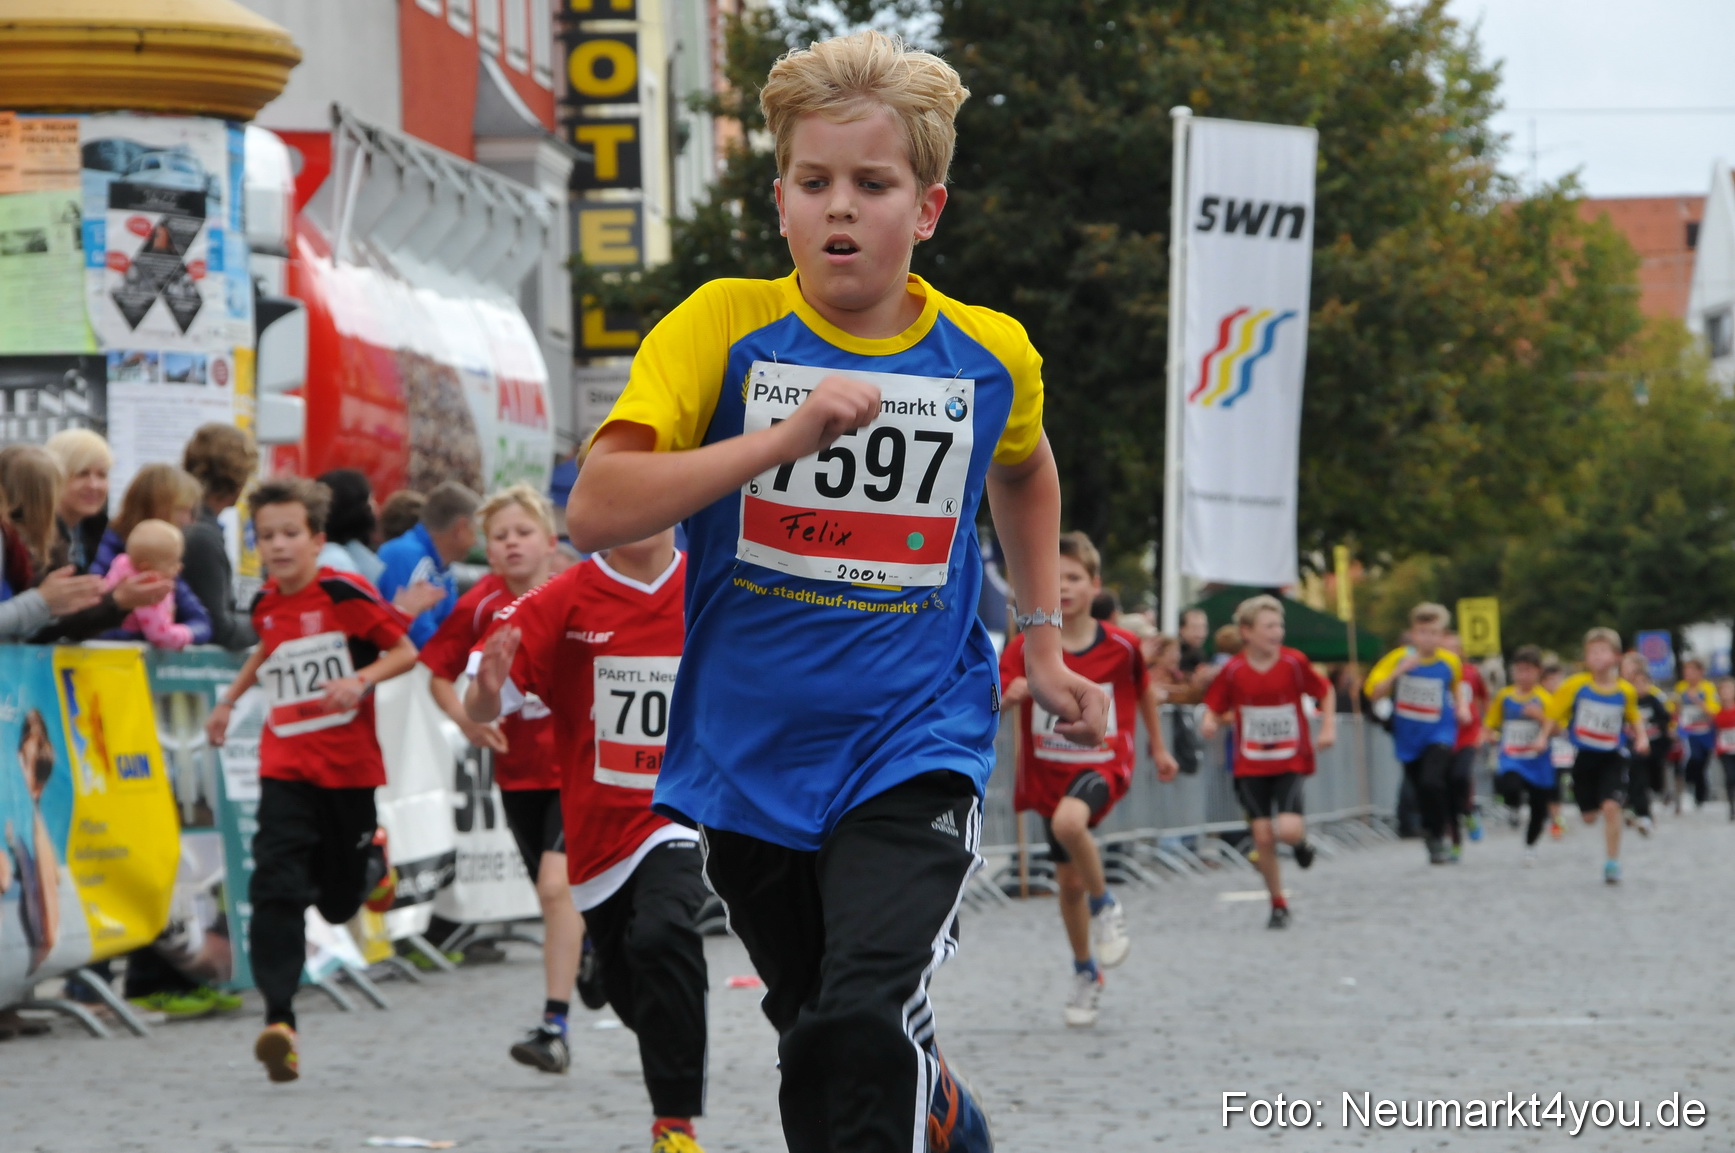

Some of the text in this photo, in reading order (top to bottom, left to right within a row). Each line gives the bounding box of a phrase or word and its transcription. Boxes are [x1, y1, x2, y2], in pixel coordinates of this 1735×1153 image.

[567, 0, 640, 348] OTEL
[1194, 194, 1306, 240] swn
[753, 383, 937, 417] PART markt
[780, 511, 853, 547] Felix
[837, 564, 887, 584] 2004
[1471, 615, 1491, 642] D
[267, 656, 344, 699] 7120
[598, 668, 677, 683] PARTL Neu
[610, 689, 667, 738] 70
